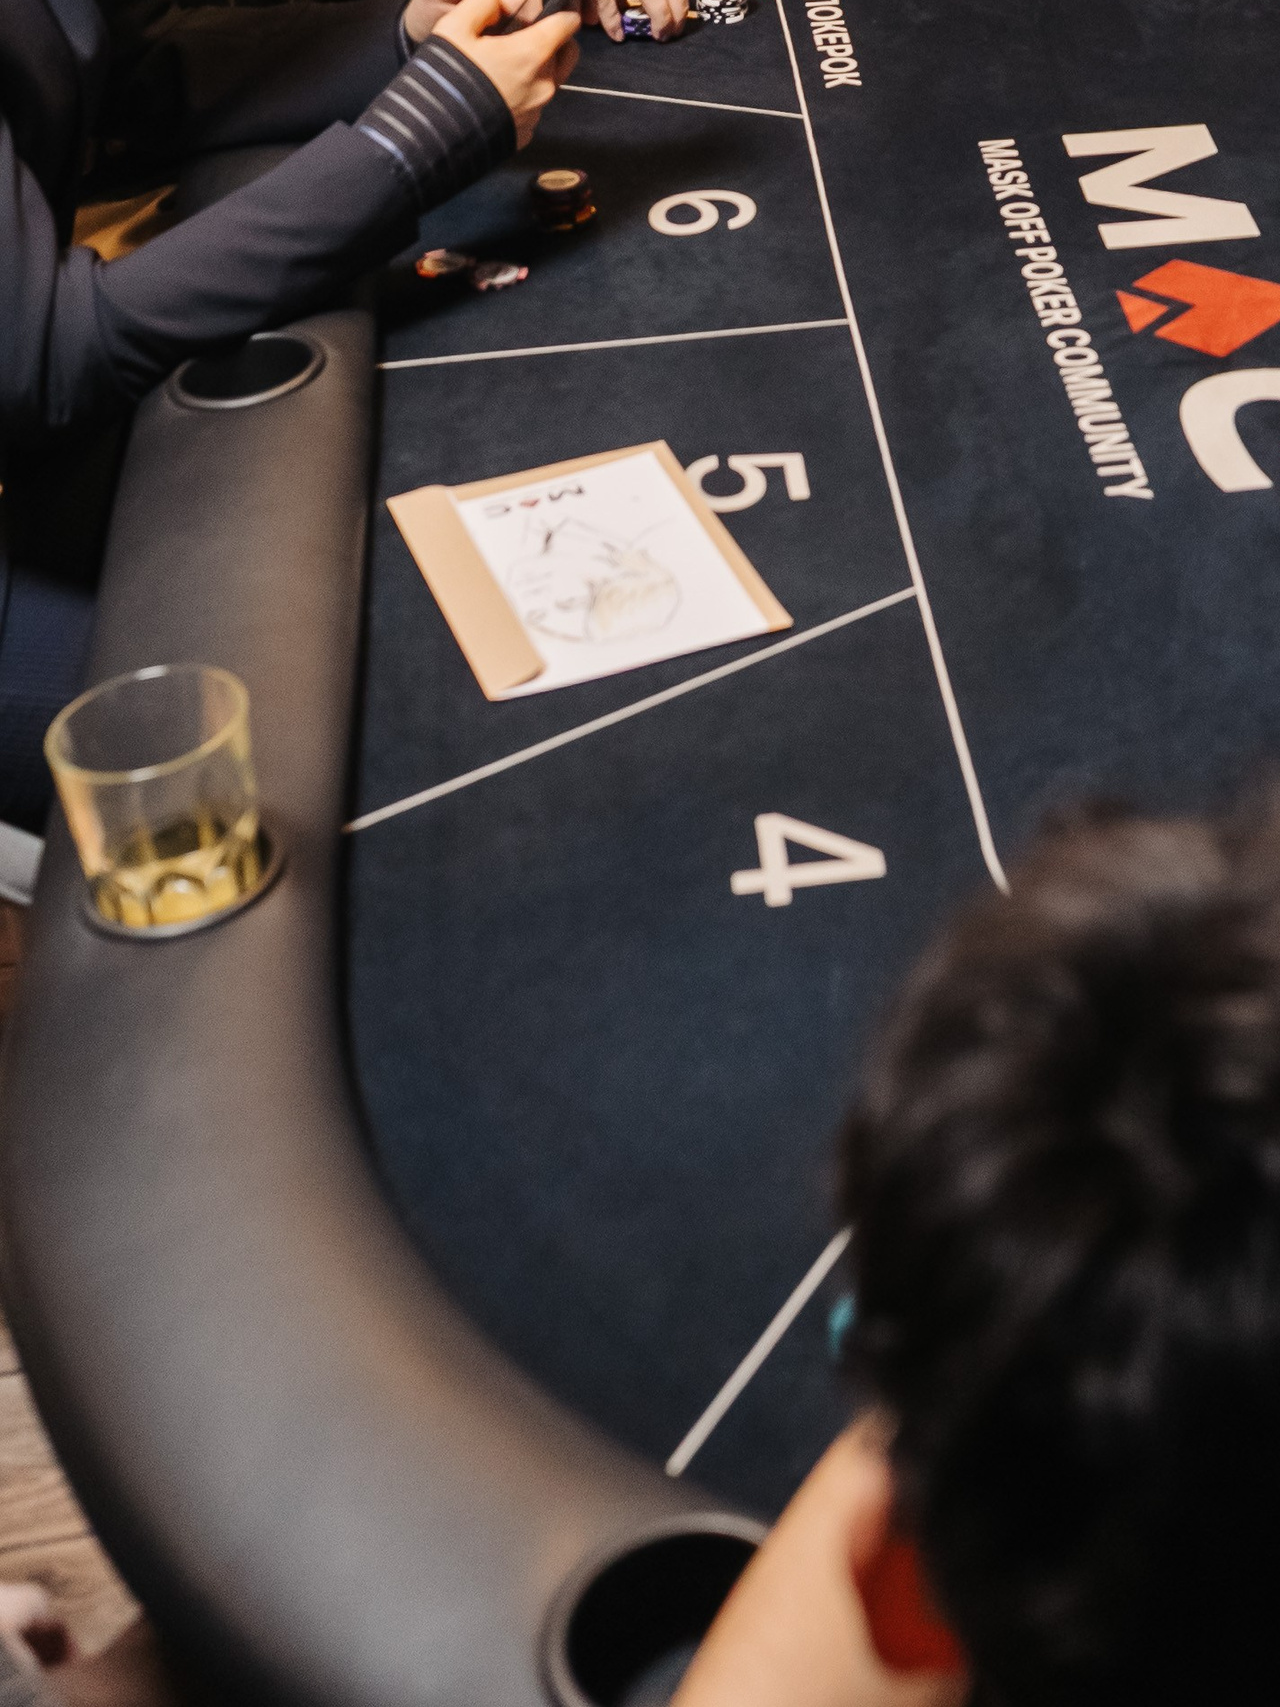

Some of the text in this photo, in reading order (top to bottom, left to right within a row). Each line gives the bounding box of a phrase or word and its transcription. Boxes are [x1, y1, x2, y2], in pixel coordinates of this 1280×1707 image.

[648, 189, 757, 236] 6
[977, 138, 1156, 500] MASK OFF POKER COMMUNITY
[684, 452, 811, 514] 5
[730, 812, 887, 908] 4
